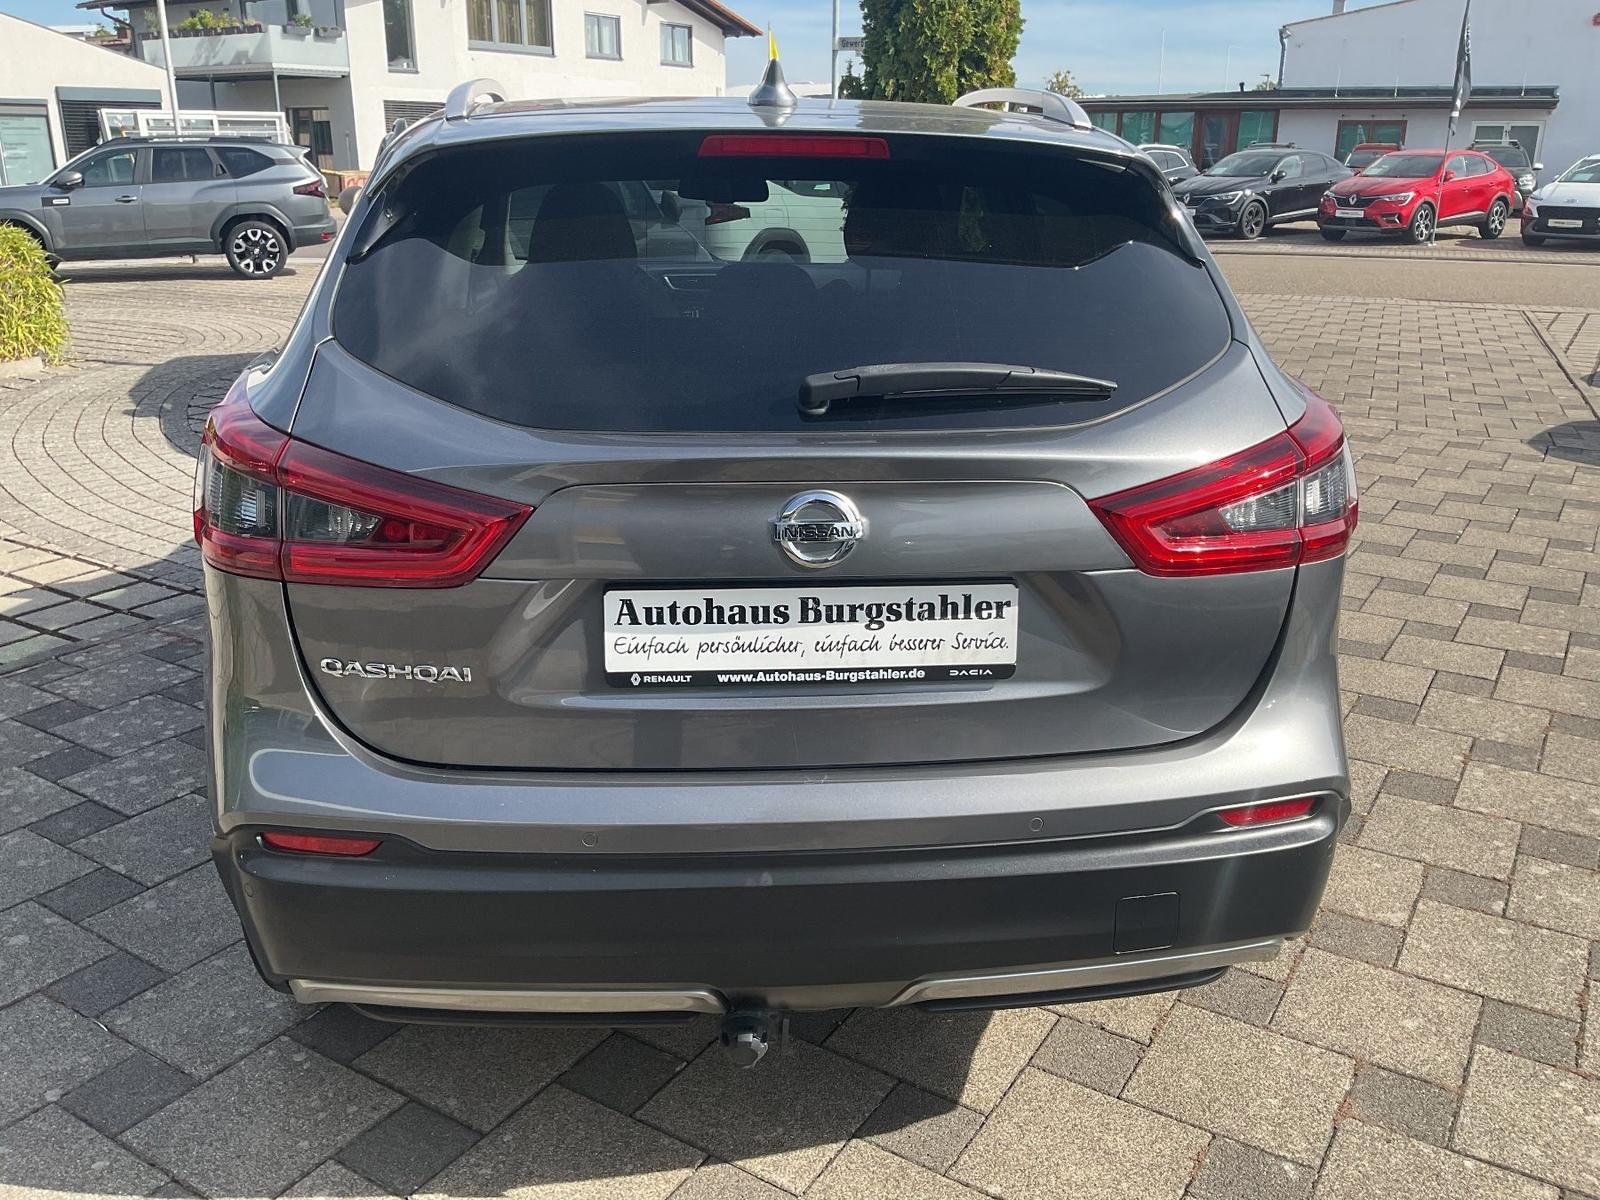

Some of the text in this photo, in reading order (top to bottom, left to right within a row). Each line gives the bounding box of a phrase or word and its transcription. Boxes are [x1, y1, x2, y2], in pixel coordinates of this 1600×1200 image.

[841, 39, 865, 49] Gewerb
[783, 525, 855, 539] NISSAN
[613, 592, 1012, 632] Autohaus Burgstahler
[613, 630, 1010, 661] Einfach persönlicher, einfach besserer Service.
[319, 657, 473, 684] QASHQAI
[716, 668, 926, 684] www.Autohaus-Burgstahler.de
[949, 669, 993, 677] DACIA
[643, 674, 693, 684] RENAULT
